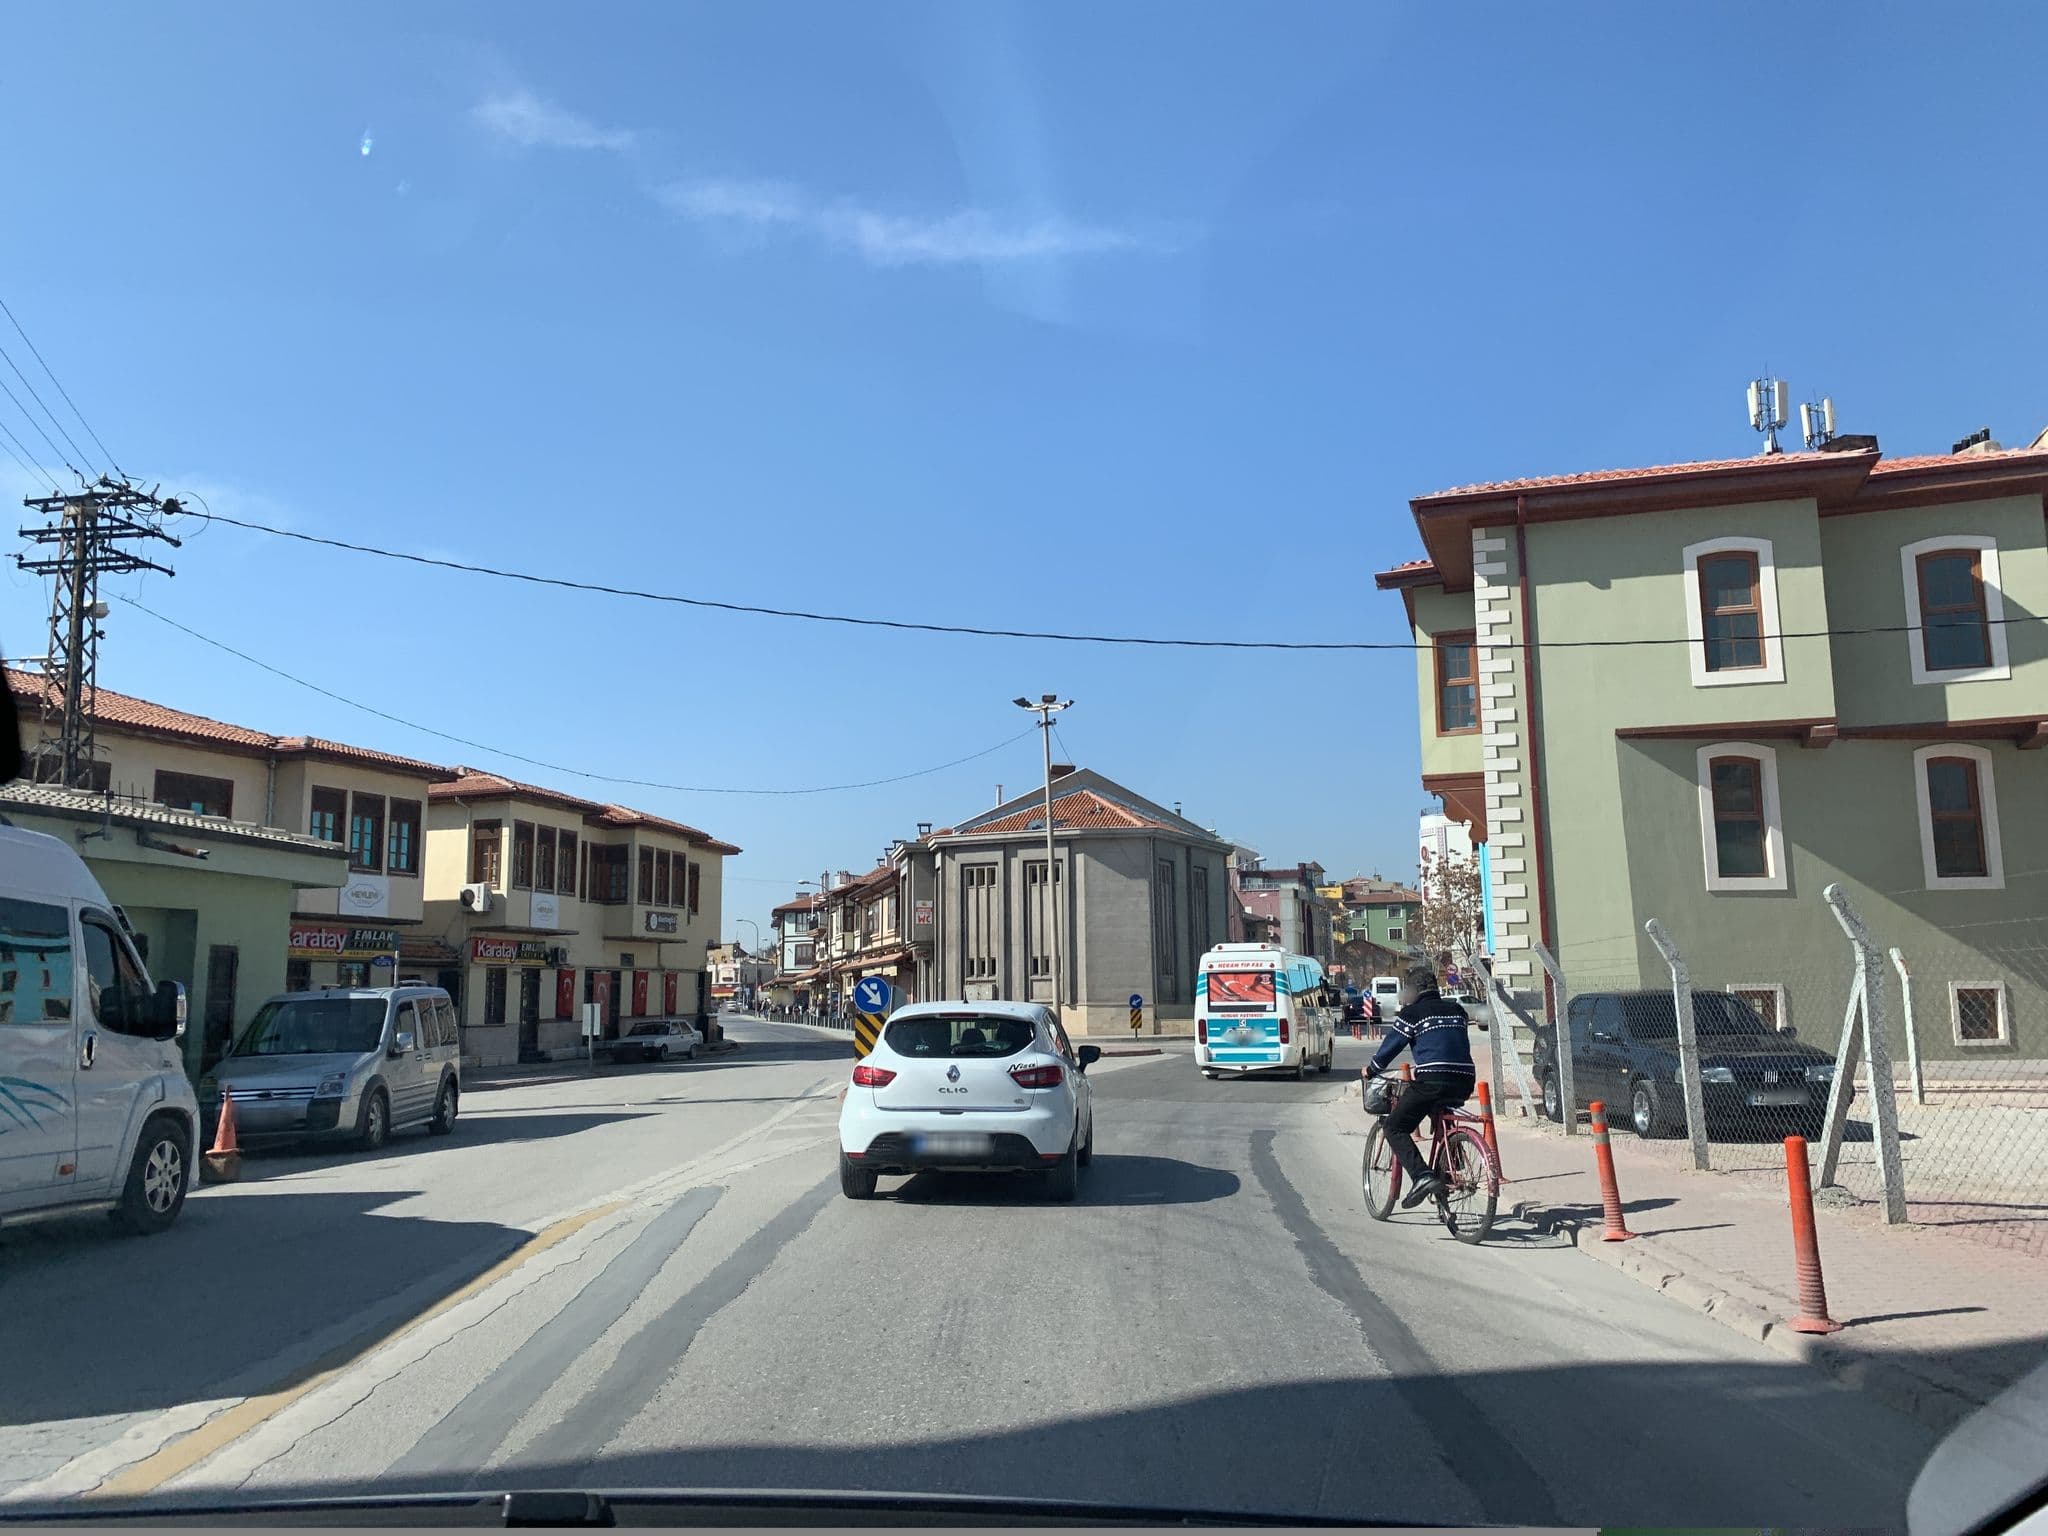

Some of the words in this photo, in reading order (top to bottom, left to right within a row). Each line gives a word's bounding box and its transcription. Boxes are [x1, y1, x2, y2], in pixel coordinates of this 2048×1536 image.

[918, 914, 931, 923] WC
[354, 930, 394, 941] EMLAK
[478, 940, 518, 962] Karatay
[1007, 1063, 1036, 1073] Nisa
